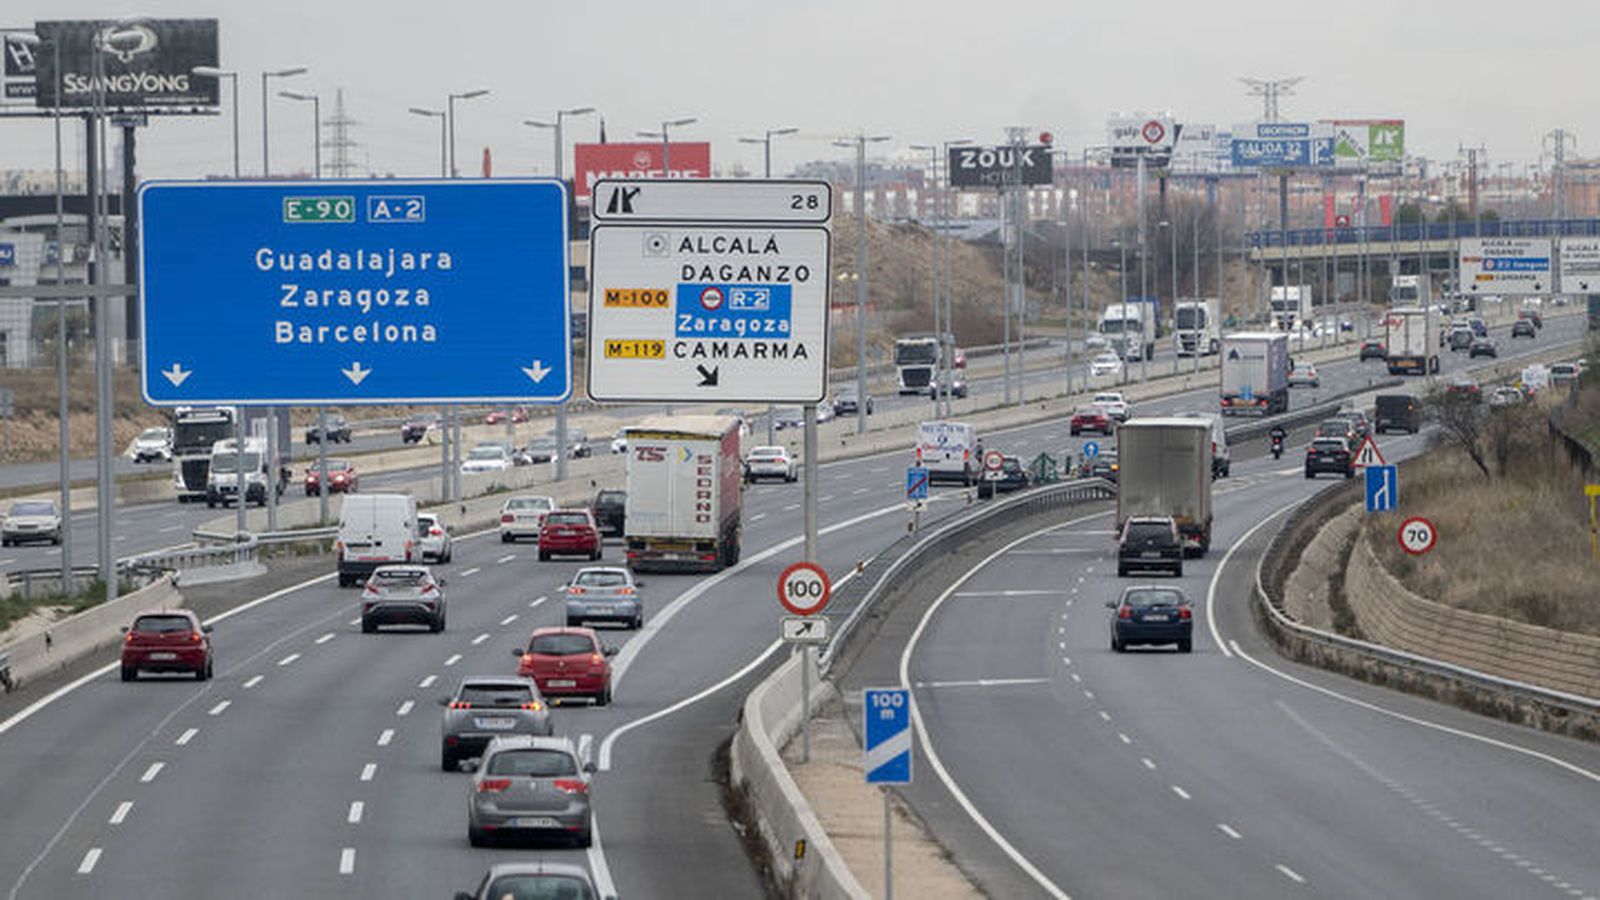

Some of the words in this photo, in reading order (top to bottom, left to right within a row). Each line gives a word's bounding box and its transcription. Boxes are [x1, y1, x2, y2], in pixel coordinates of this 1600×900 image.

[961, 150, 1034, 168] ZOUK
[287, 201, 350, 219] E-90
[374, 200, 422, 219] A-2
[791, 195, 819, 210] 28
[678, 235, 780, 254] ALCALÁ
[256, 248, 453, 277] Guadalajara
[681, 265, 810, 282] DAGANZO
[280, 284, 431, 313] Zaragoza
[605, 291, 668, 306] M-100
[731, 291, 767, 307] R-2
[275, 321, 438, 344] Barcelona
[677, 314, 790, 337] Zaragoza
[608, 342, 663, 357] M-119
[673, 342, 808, 359] CAMARMA
[1408, 529, 1428, 543] 70
[787, 580, 822, 598] 100
[871, 693, 904, 708] 100
[880, 708, 896, 720] m
